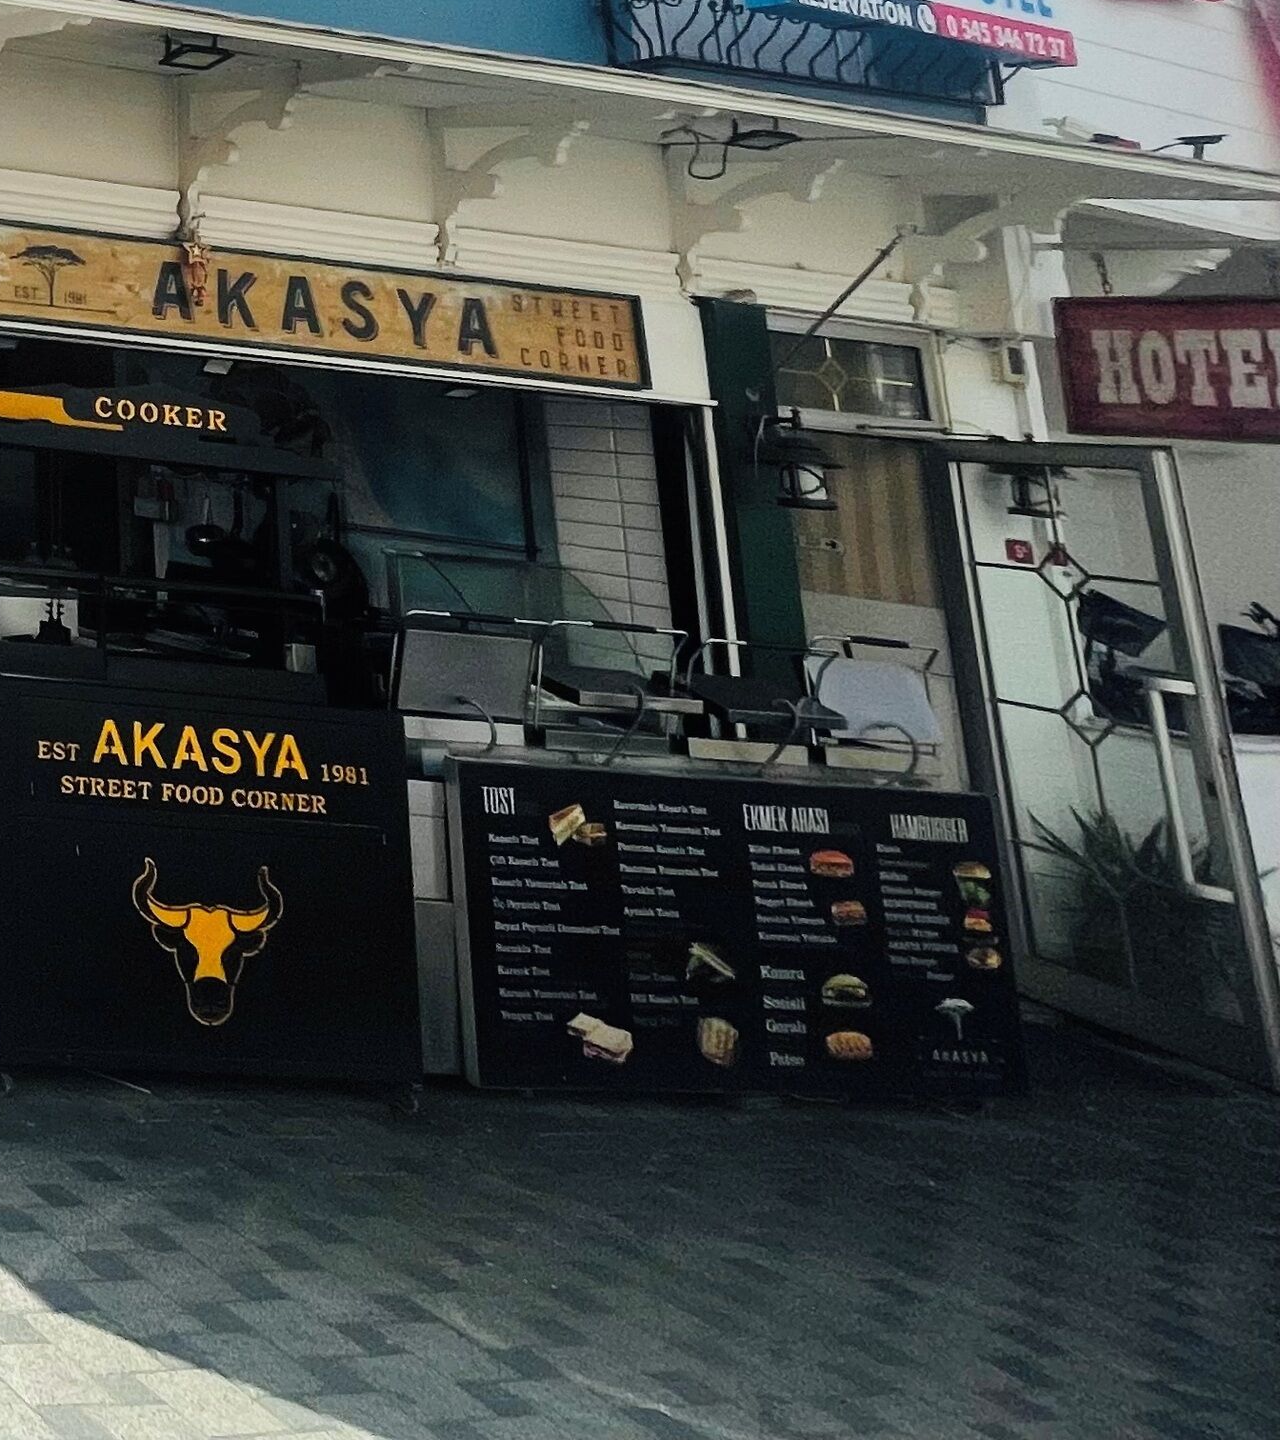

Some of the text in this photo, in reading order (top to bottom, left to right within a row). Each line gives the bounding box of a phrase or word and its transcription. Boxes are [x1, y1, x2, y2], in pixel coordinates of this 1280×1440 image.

[946, 15, 958, 37] 0
[14, 285, 39, 299] EST
[151, 260, 499, 359] AKASYA
[512, 294, 619, 324] STREET
[557, 326, 623, 352] FOOD
[520, 347, 628, 378] CORNER
[94, 396, 228, 433] COOKER
[37, 719, 371, 786] EST AKASYA 1981
[60, 775, 328, 815] STREET FOOD CORNER
[480, 786, 515, 815] TOST
[742, 803, 789, 832] EKMEK
